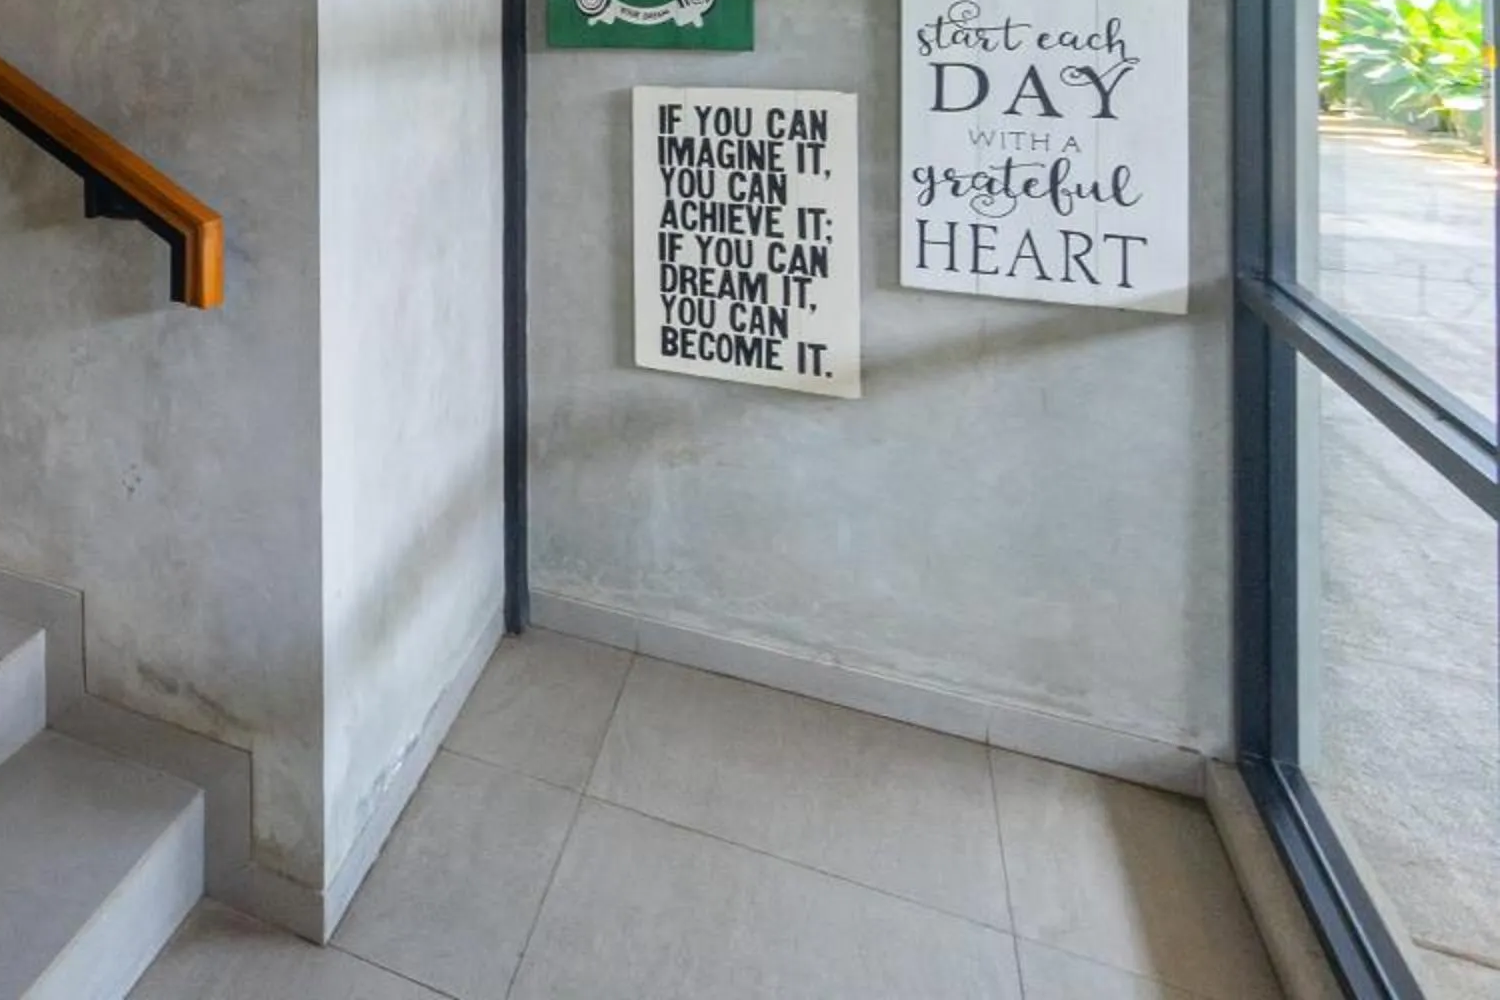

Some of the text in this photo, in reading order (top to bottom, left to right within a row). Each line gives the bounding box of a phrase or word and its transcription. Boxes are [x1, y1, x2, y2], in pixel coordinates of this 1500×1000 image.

[917, 0, 1126, 60] start each
[928, 58, 1140, 120] DAY
[658, 104, 828, 141] IF YOU CAN
[968, 128, 1082, 153] WITH A
[657, 135, 832, 180] IMAGINE IT,
[659, 167, 788, 206] YOU CAN
[912, 157, 1143, 218] grateful
[659, 199, 833, 245] ACHIEVE IT;
[658, 232, 829, 278] IF YOU CAN
[915, 218, 1148, 289] HEART
[659, 263, 817, 314] DREAM IT,
[659, 293, 789, 339] YOU CAN
[660, 326, 833, 379] BECOME IT.
